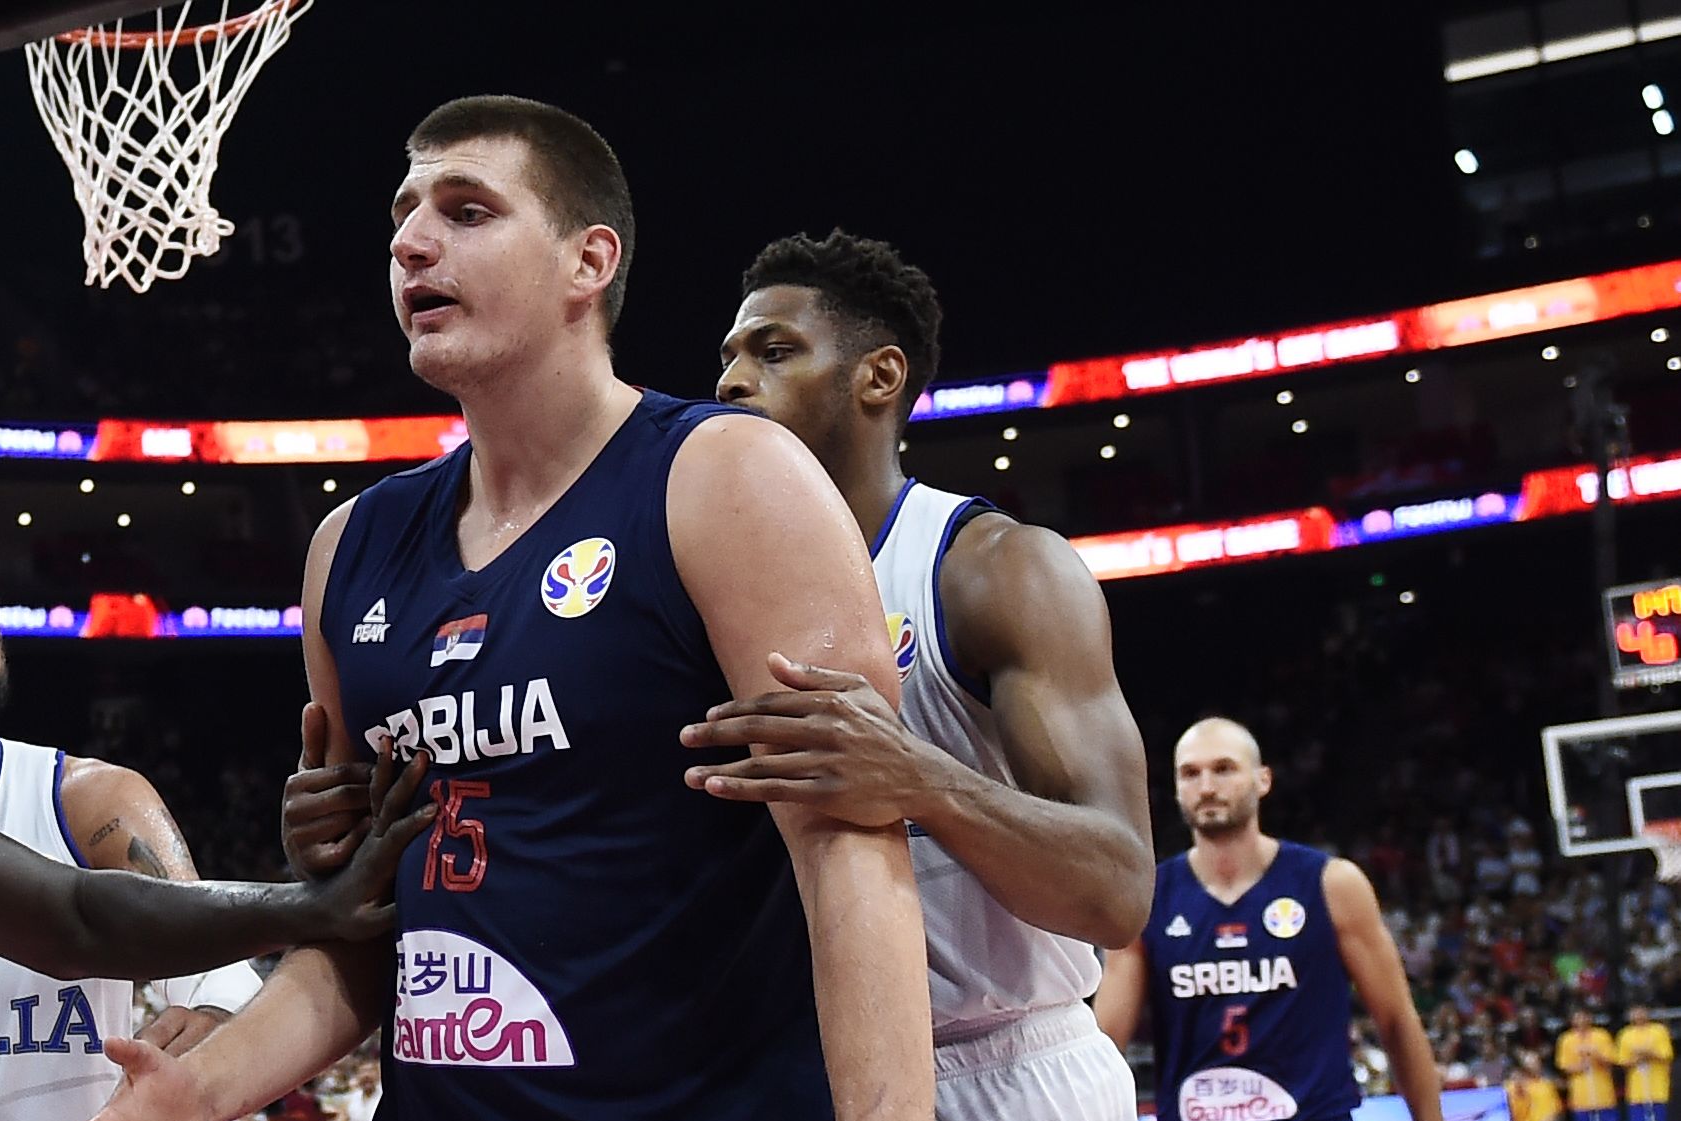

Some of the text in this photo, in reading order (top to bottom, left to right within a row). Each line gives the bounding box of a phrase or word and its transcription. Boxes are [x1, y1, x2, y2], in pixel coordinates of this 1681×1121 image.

[351, 622, 392, 644] PEAK
[422, 779, 491, 892] 15
[1170, 955, 1299, 999] SRBIJA
[1221, 1004, 1251, 1057] 5
